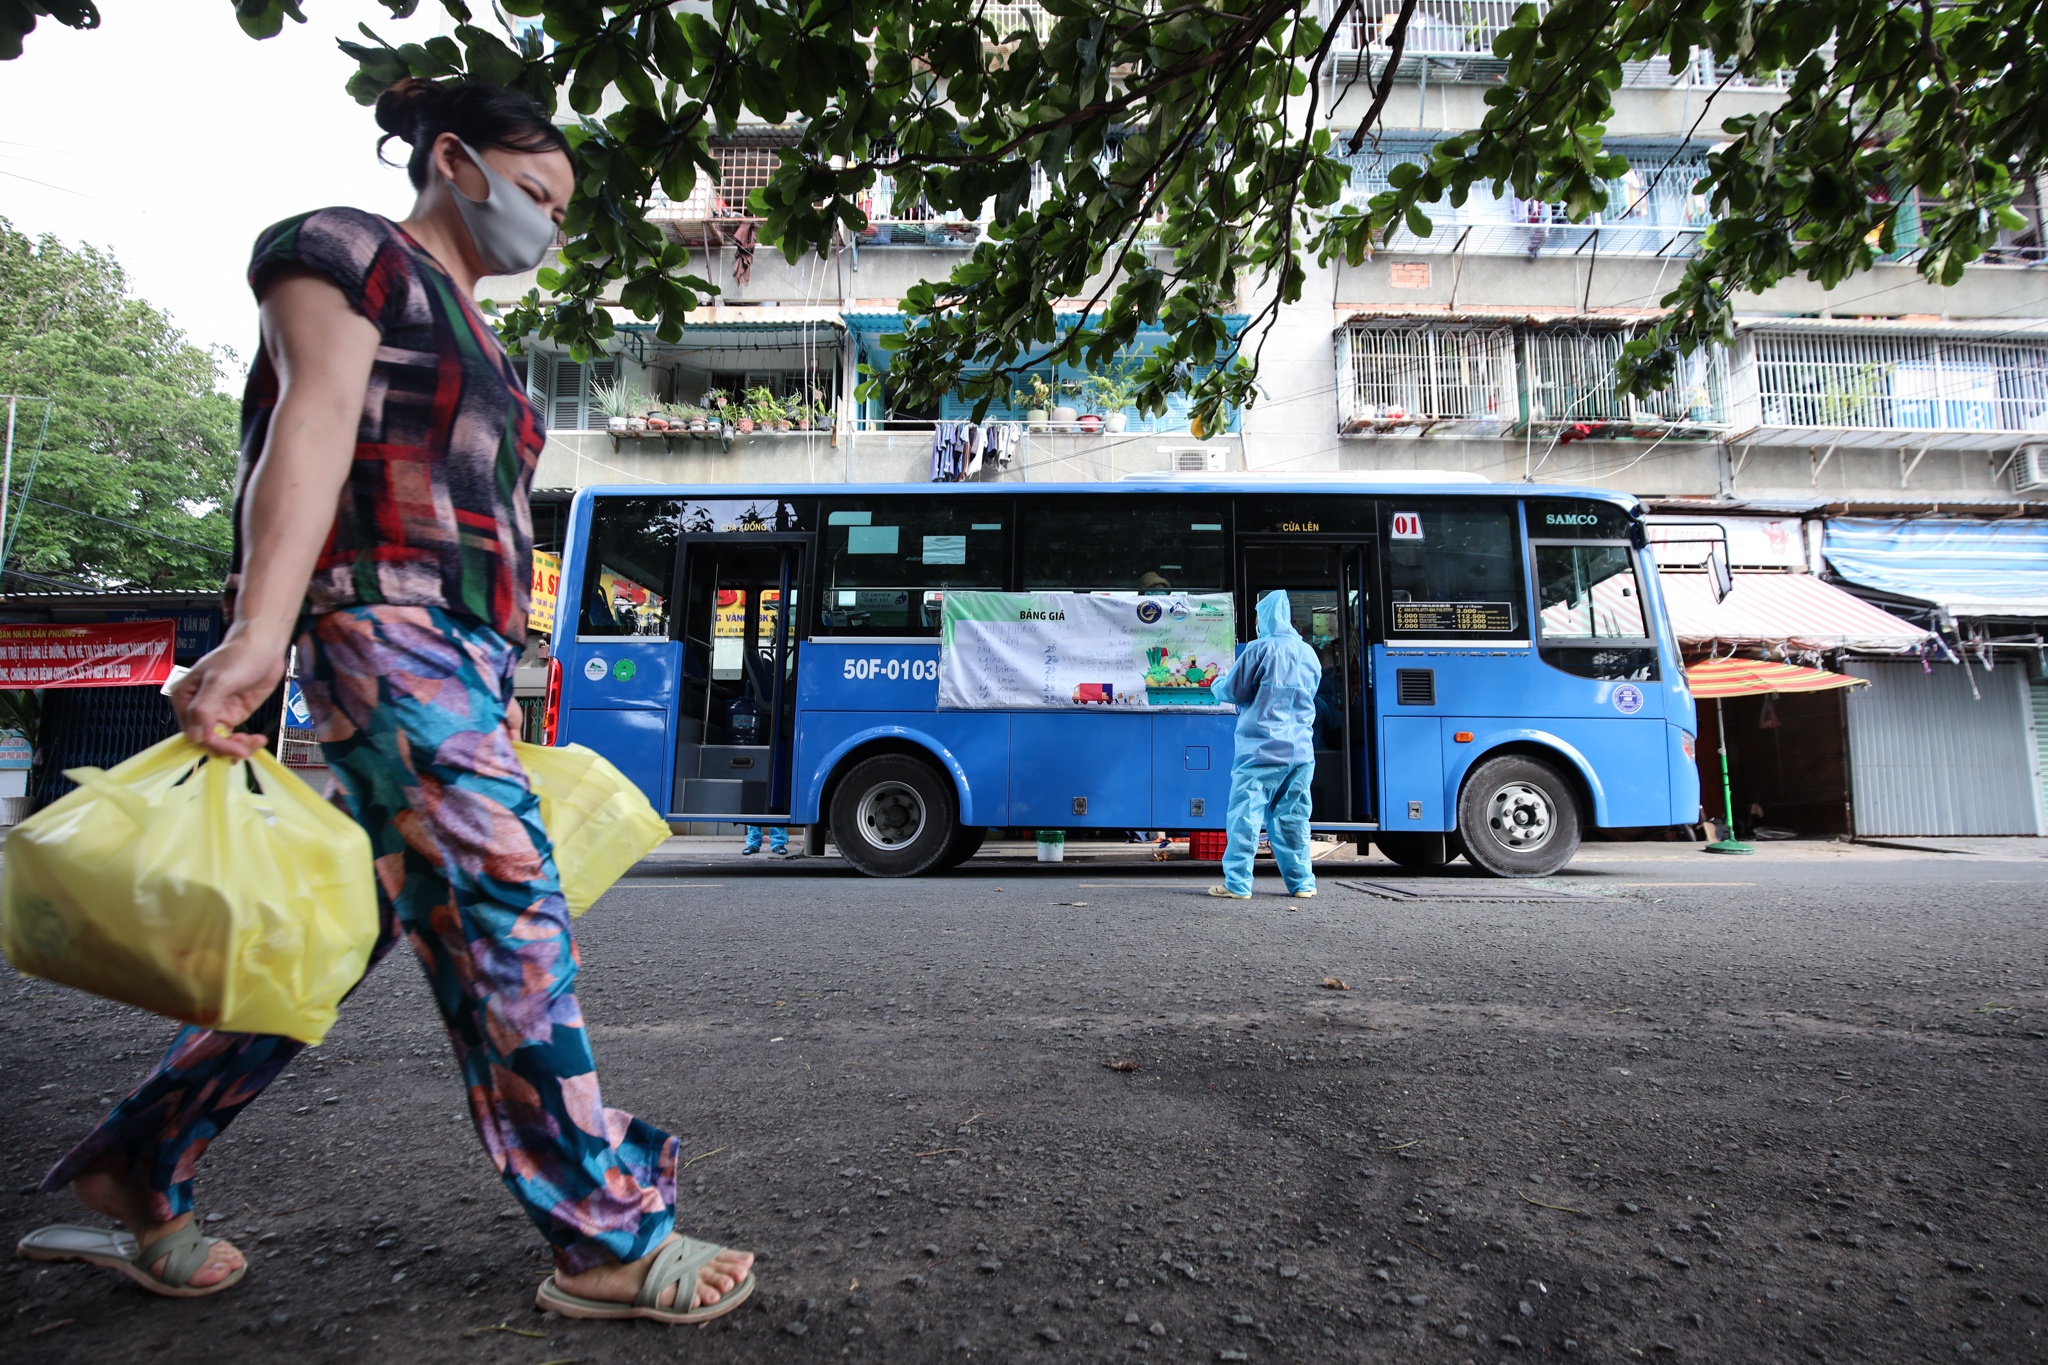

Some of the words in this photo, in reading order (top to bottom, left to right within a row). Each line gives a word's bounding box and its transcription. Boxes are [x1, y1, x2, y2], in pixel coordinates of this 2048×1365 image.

[739, 520, 767, 531] XUỐNG
[1395, 516, 1419, 535] 01
[1546, 514, 1598, 525] SAMCO
[1282, 520, 1301, 532] CỬA
[1302, 520, 1319, 532] LÊN
[1019, 608, 1046, 620] BẢNG
[1048, 609, 1065, 621] GIÁ
[843, 659, 940, 680] 50F-0103
